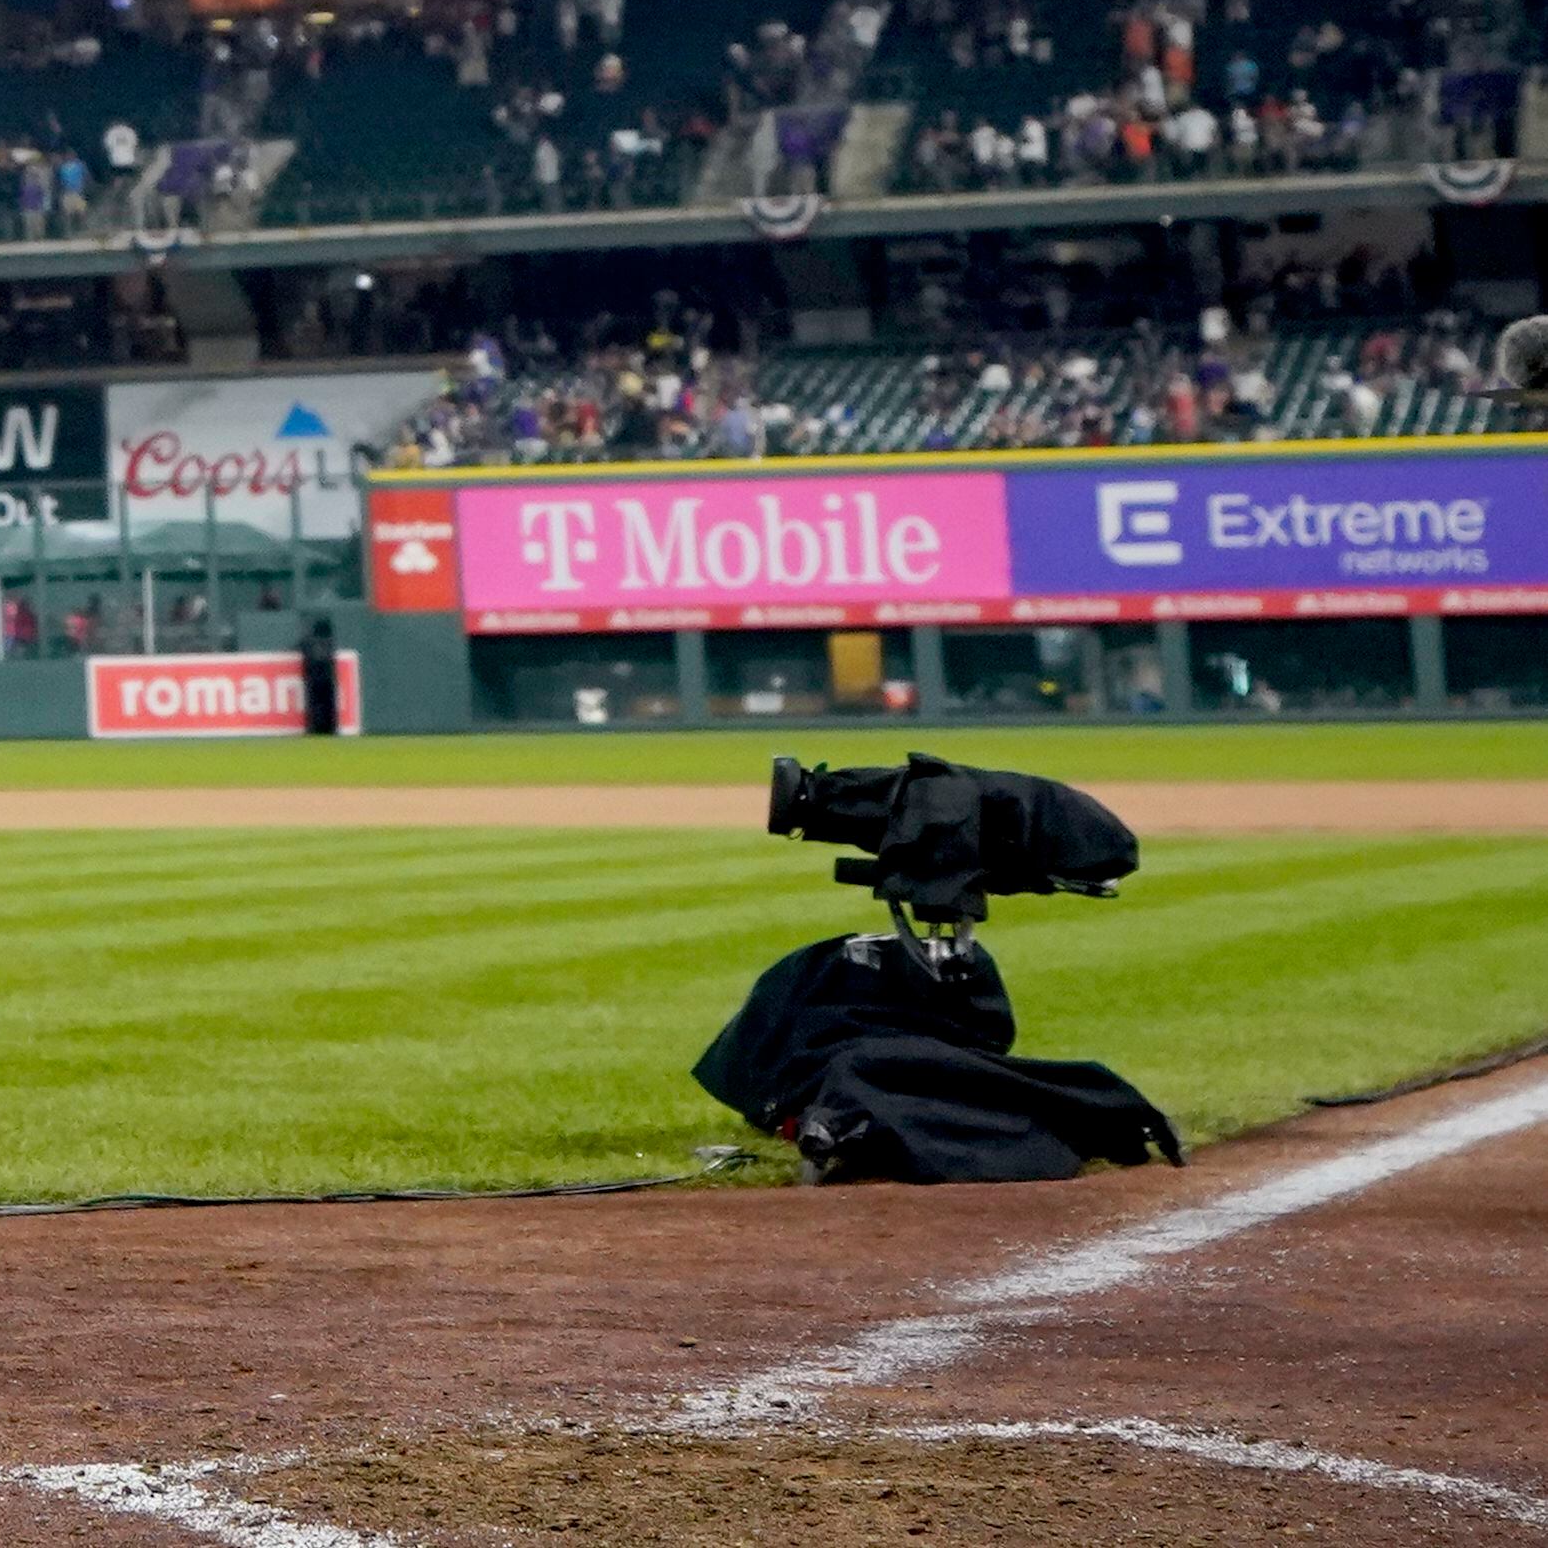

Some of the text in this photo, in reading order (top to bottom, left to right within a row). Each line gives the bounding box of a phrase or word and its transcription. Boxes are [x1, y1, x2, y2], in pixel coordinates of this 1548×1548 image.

[122, 431, 299, 499] Coors
[614, 492, 941, 589] Mobile
[1207, 494, 1485, 548] Extreme
